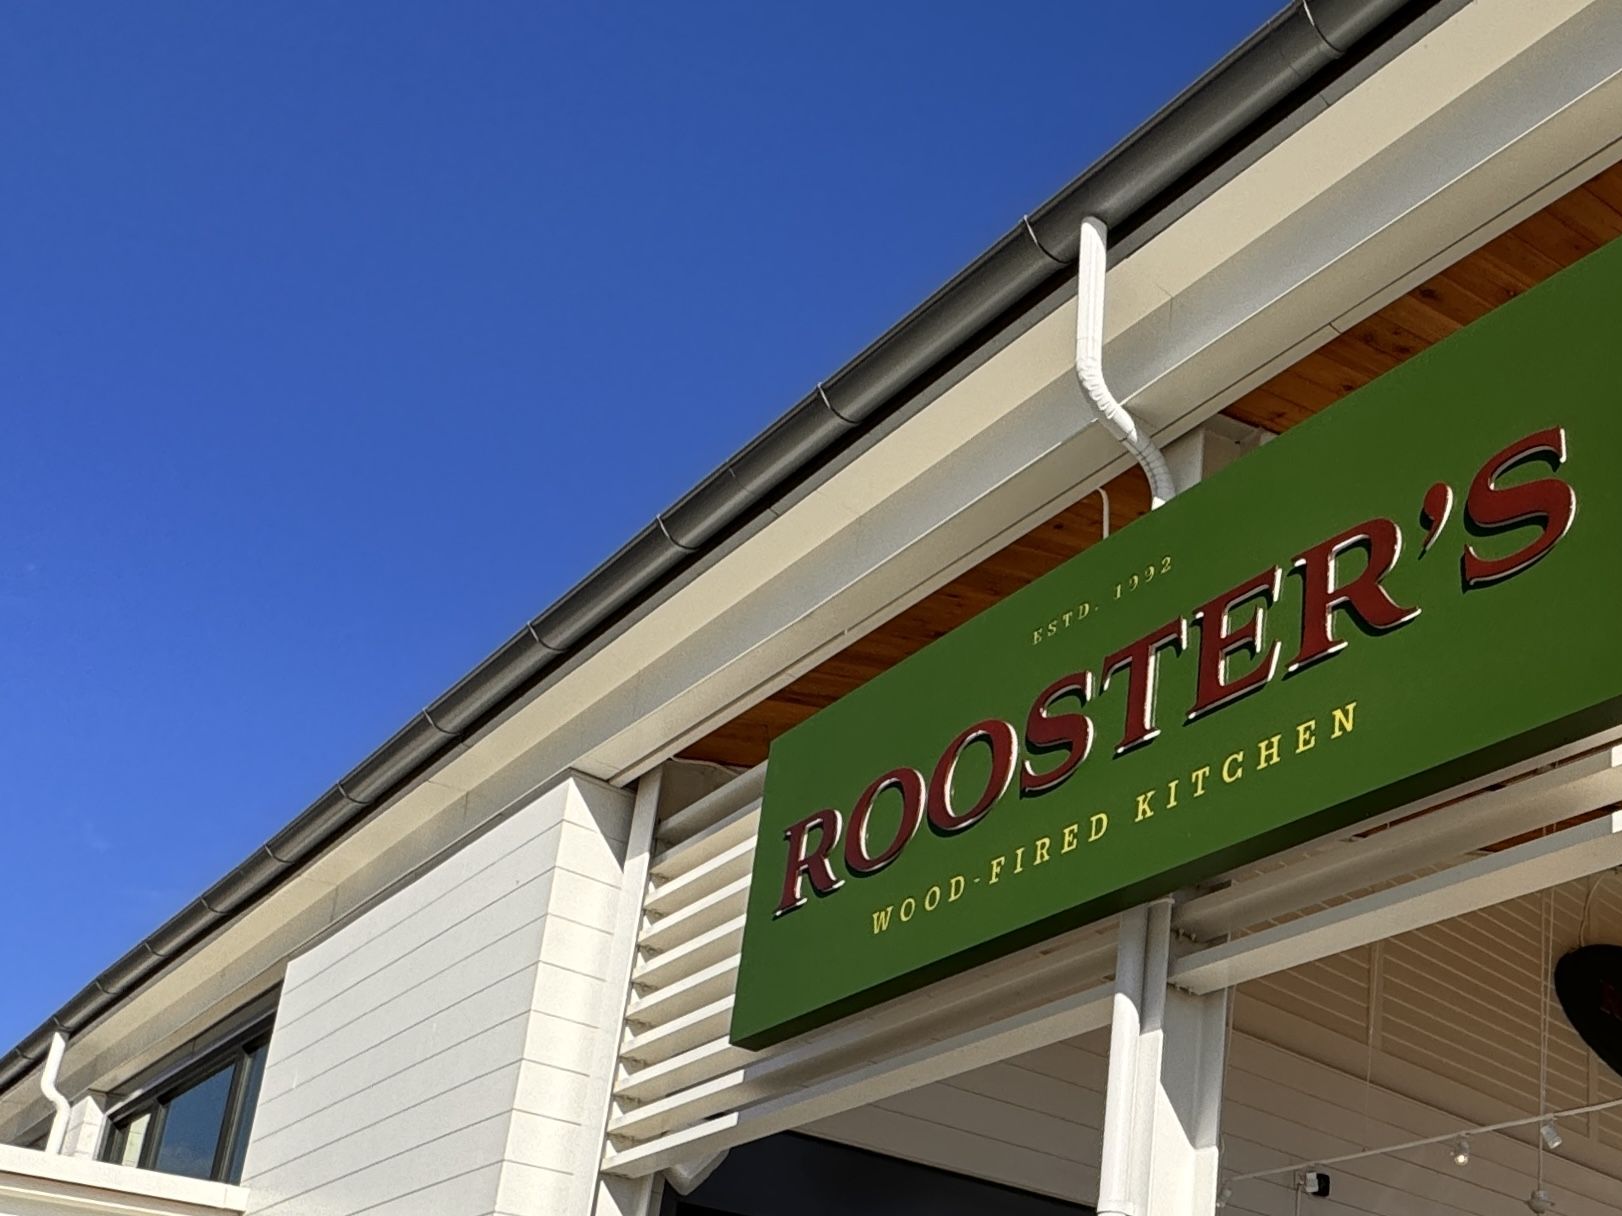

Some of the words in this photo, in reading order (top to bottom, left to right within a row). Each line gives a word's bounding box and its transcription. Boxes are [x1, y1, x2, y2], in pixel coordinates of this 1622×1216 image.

[772, 425, 1577, 919] ROOSTER'S
[1031, 602, 1100, 646] ESTD.
[1113, 556, 1172, 600] 1992
[871, 812, 1109, 935] WOOD-FIRED
[1134, 702, 1357, 823] KITCHEN
